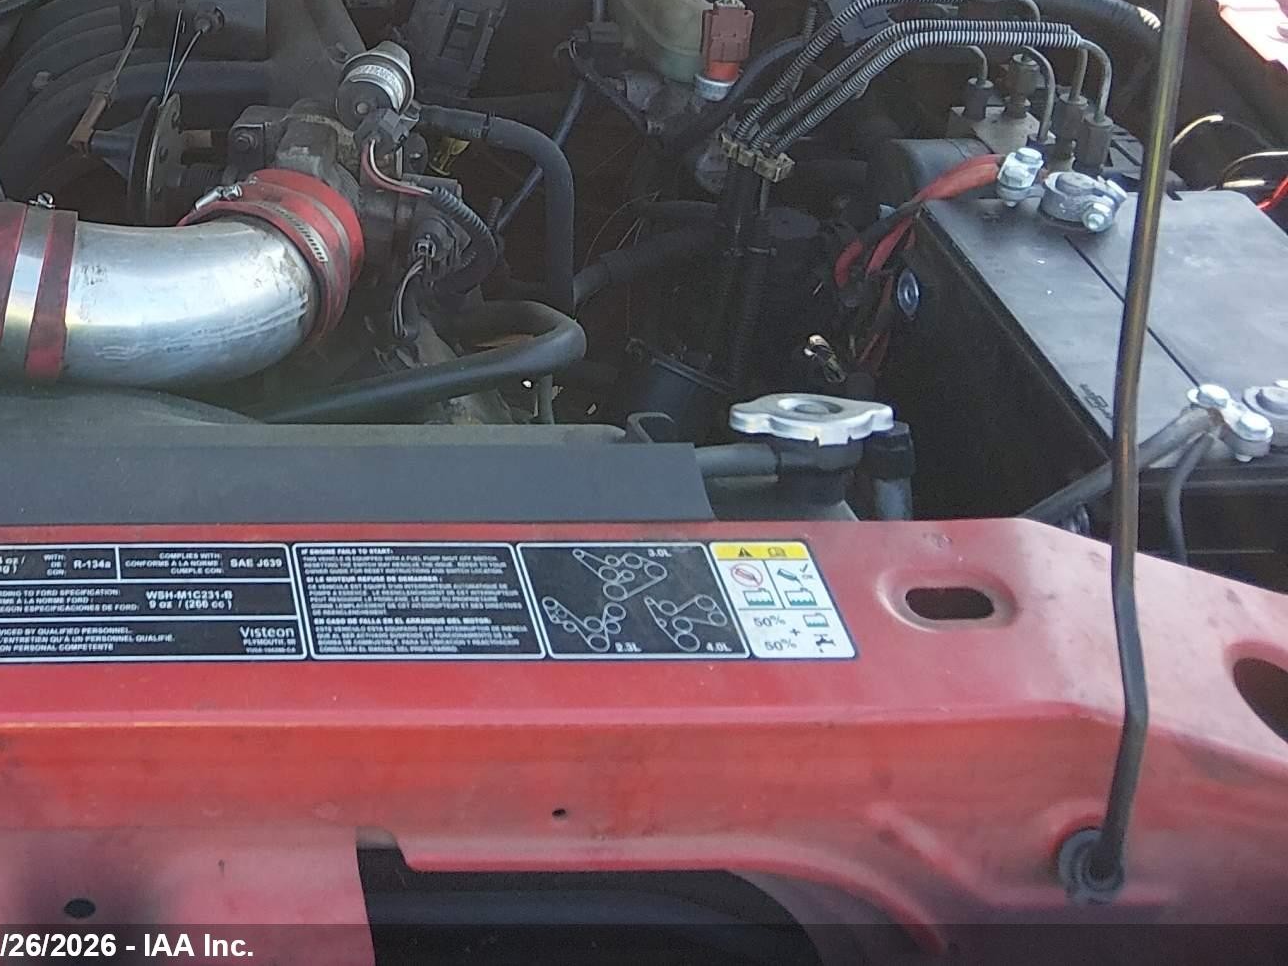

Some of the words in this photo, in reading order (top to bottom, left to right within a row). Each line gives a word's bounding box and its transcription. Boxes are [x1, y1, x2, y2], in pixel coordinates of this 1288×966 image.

[158, 552, 198, 560] COMPLIES
[648, 549, 671, 558] 3.0L
[5, 557, 18, 565] oz
[73, 559, 112, 569] R-134a
[230, 558, 254, 568] SAE
[256, 558, 282, 568] J639
[170, 567, 202, 575] CUMPLE
[66, 596, 89, 604] FORD
[149, 599, 156, 609] 9
[158, 601, 173, 609] oz
[753, 616, 785, 628] 50%
[239, 626, 295, 639] Visteon
[58, 643, 114, 651] COMPETENTE
[706, 642, 732, 652] 4.0L
[764, 639, 796, 652] 50%
